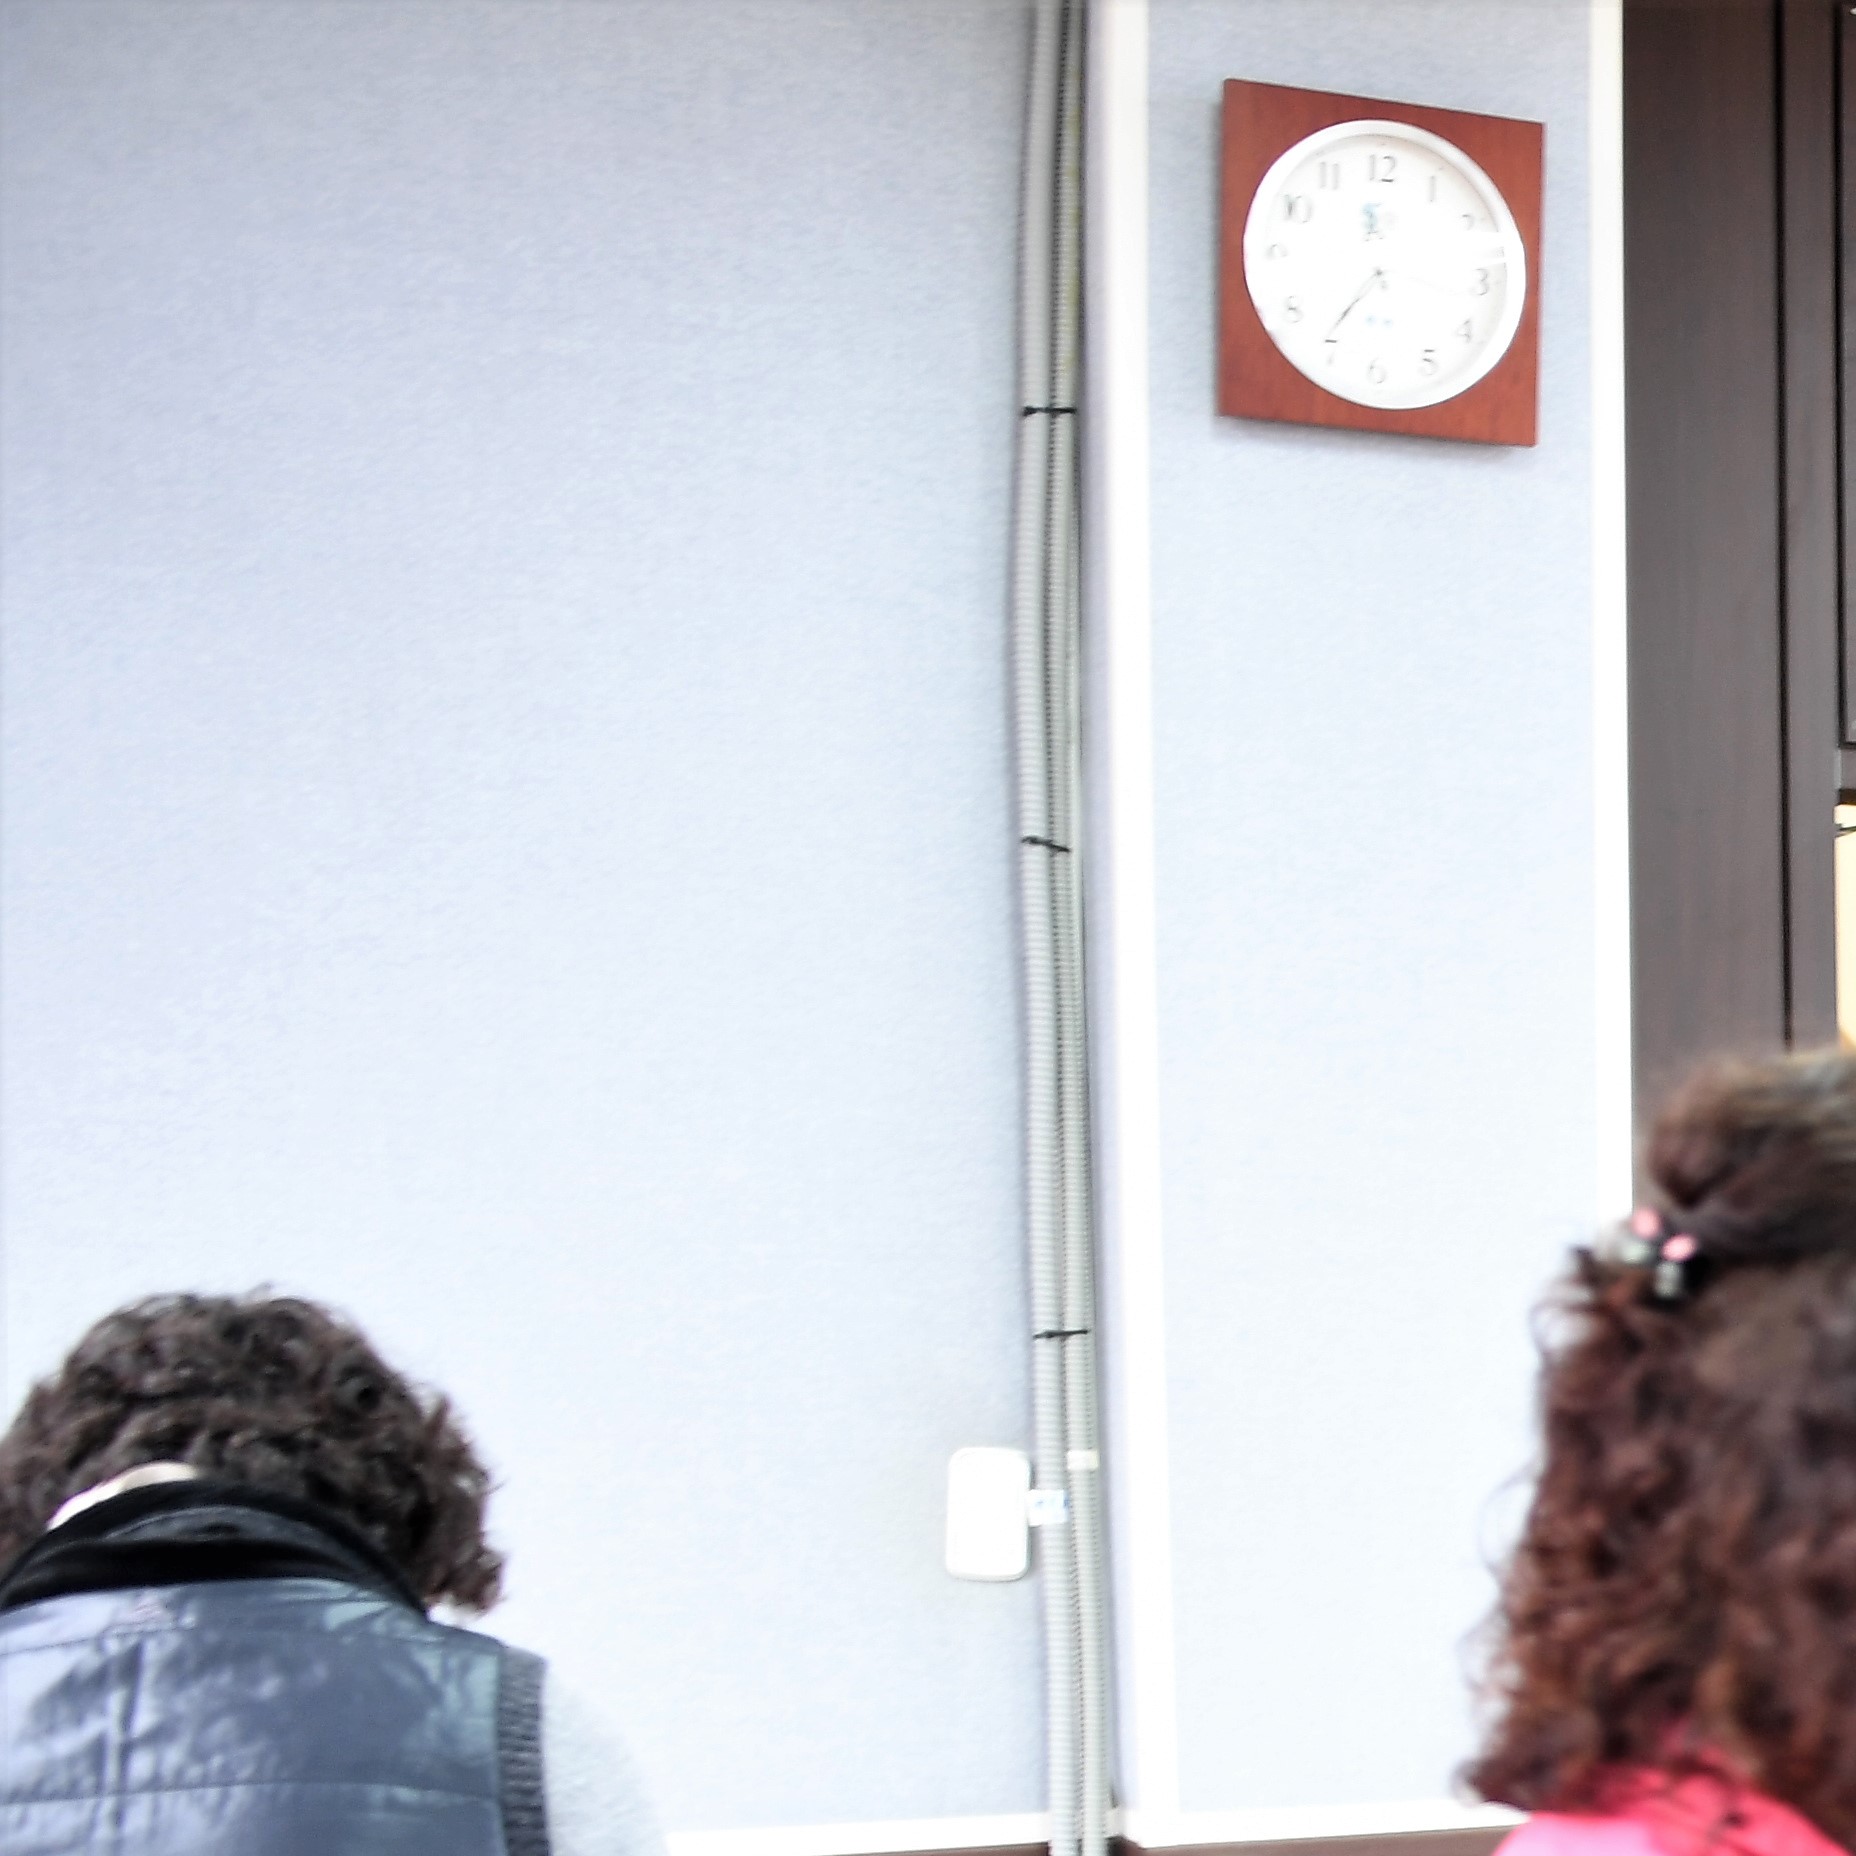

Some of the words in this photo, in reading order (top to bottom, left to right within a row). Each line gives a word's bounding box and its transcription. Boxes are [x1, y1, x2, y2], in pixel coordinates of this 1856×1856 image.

[1318, 160, 1341, 190] 11
[1368, 153, 1399, 183] 12
[1429, 173, 1438, 203] 1
[1469, 267, 1490, 297] 3
[1366, 357, 1388, 385] 6
[1417, 347, 1440, 377] 5
